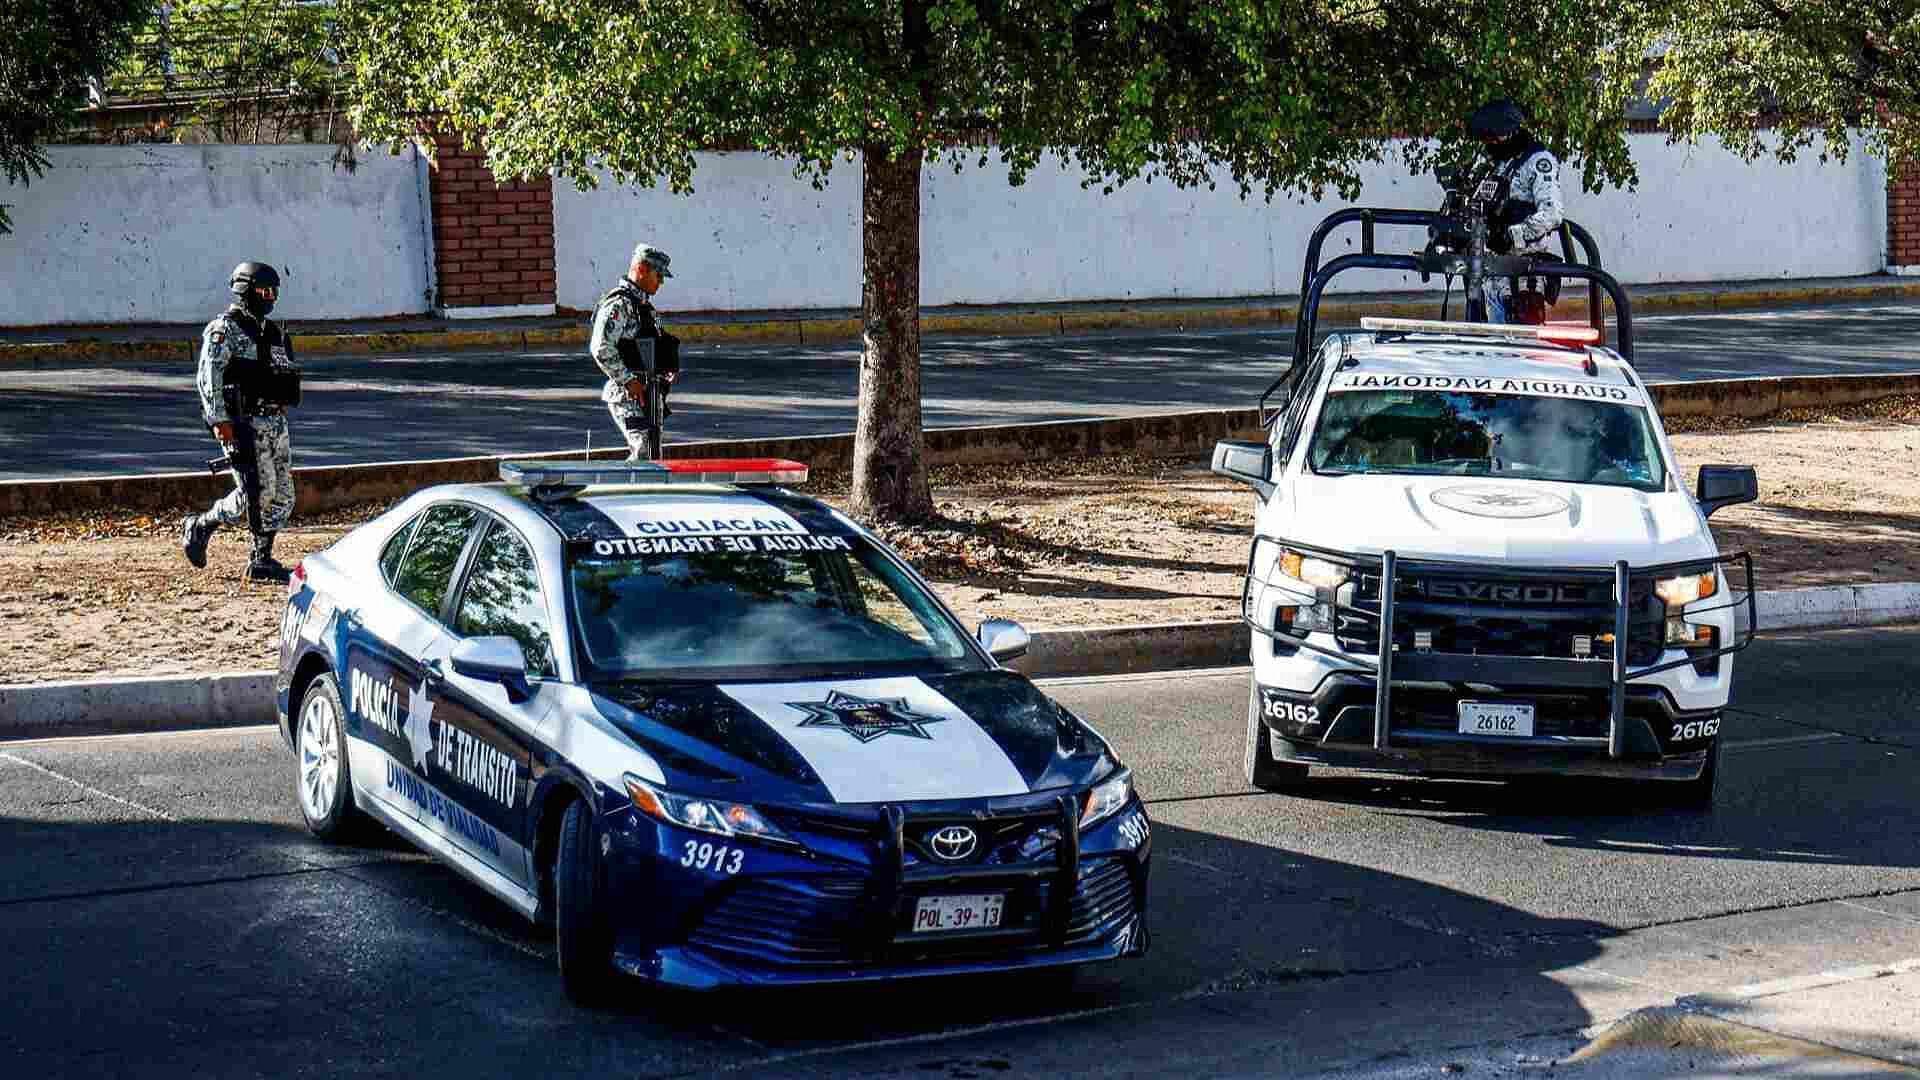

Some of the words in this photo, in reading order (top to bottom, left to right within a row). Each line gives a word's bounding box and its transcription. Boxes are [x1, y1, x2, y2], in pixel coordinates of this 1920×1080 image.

[1264, 692, 1321, 725] 26162
[1477, 713, 1517, 731] 26162
[437, 719, 456, 774] DE
[455, 729, 518, 809] TRANSITO
[680, 839, 745, 875] 3913
[916, 906, 1001, 929] POL-39-13
